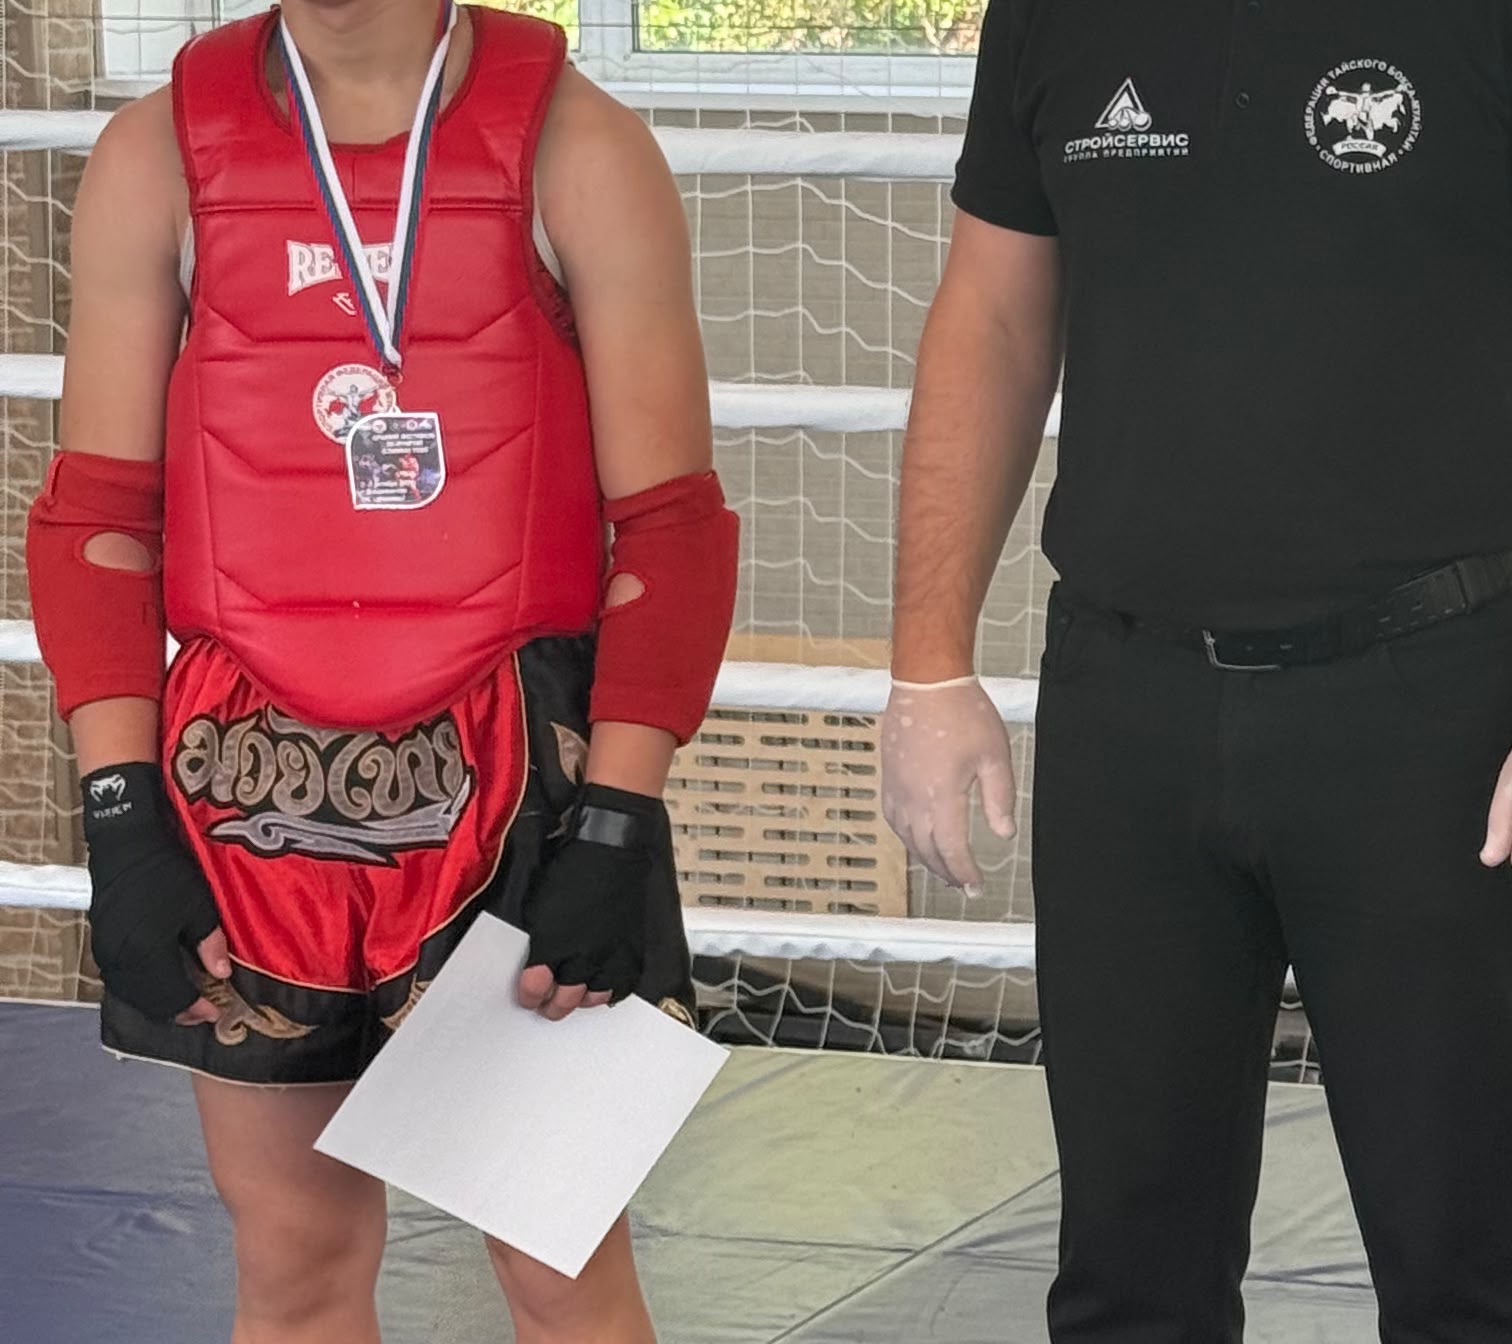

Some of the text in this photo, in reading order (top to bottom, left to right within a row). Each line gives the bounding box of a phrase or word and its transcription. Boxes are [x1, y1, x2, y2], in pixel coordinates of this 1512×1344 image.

[1327, 58, 1387, 80] ТАЙСКОГО
[1064, 132, 1189, 154] СТРОЙСЕРВИС
[1319, 150, 1398, 174] СПОРТИВНАЯ
